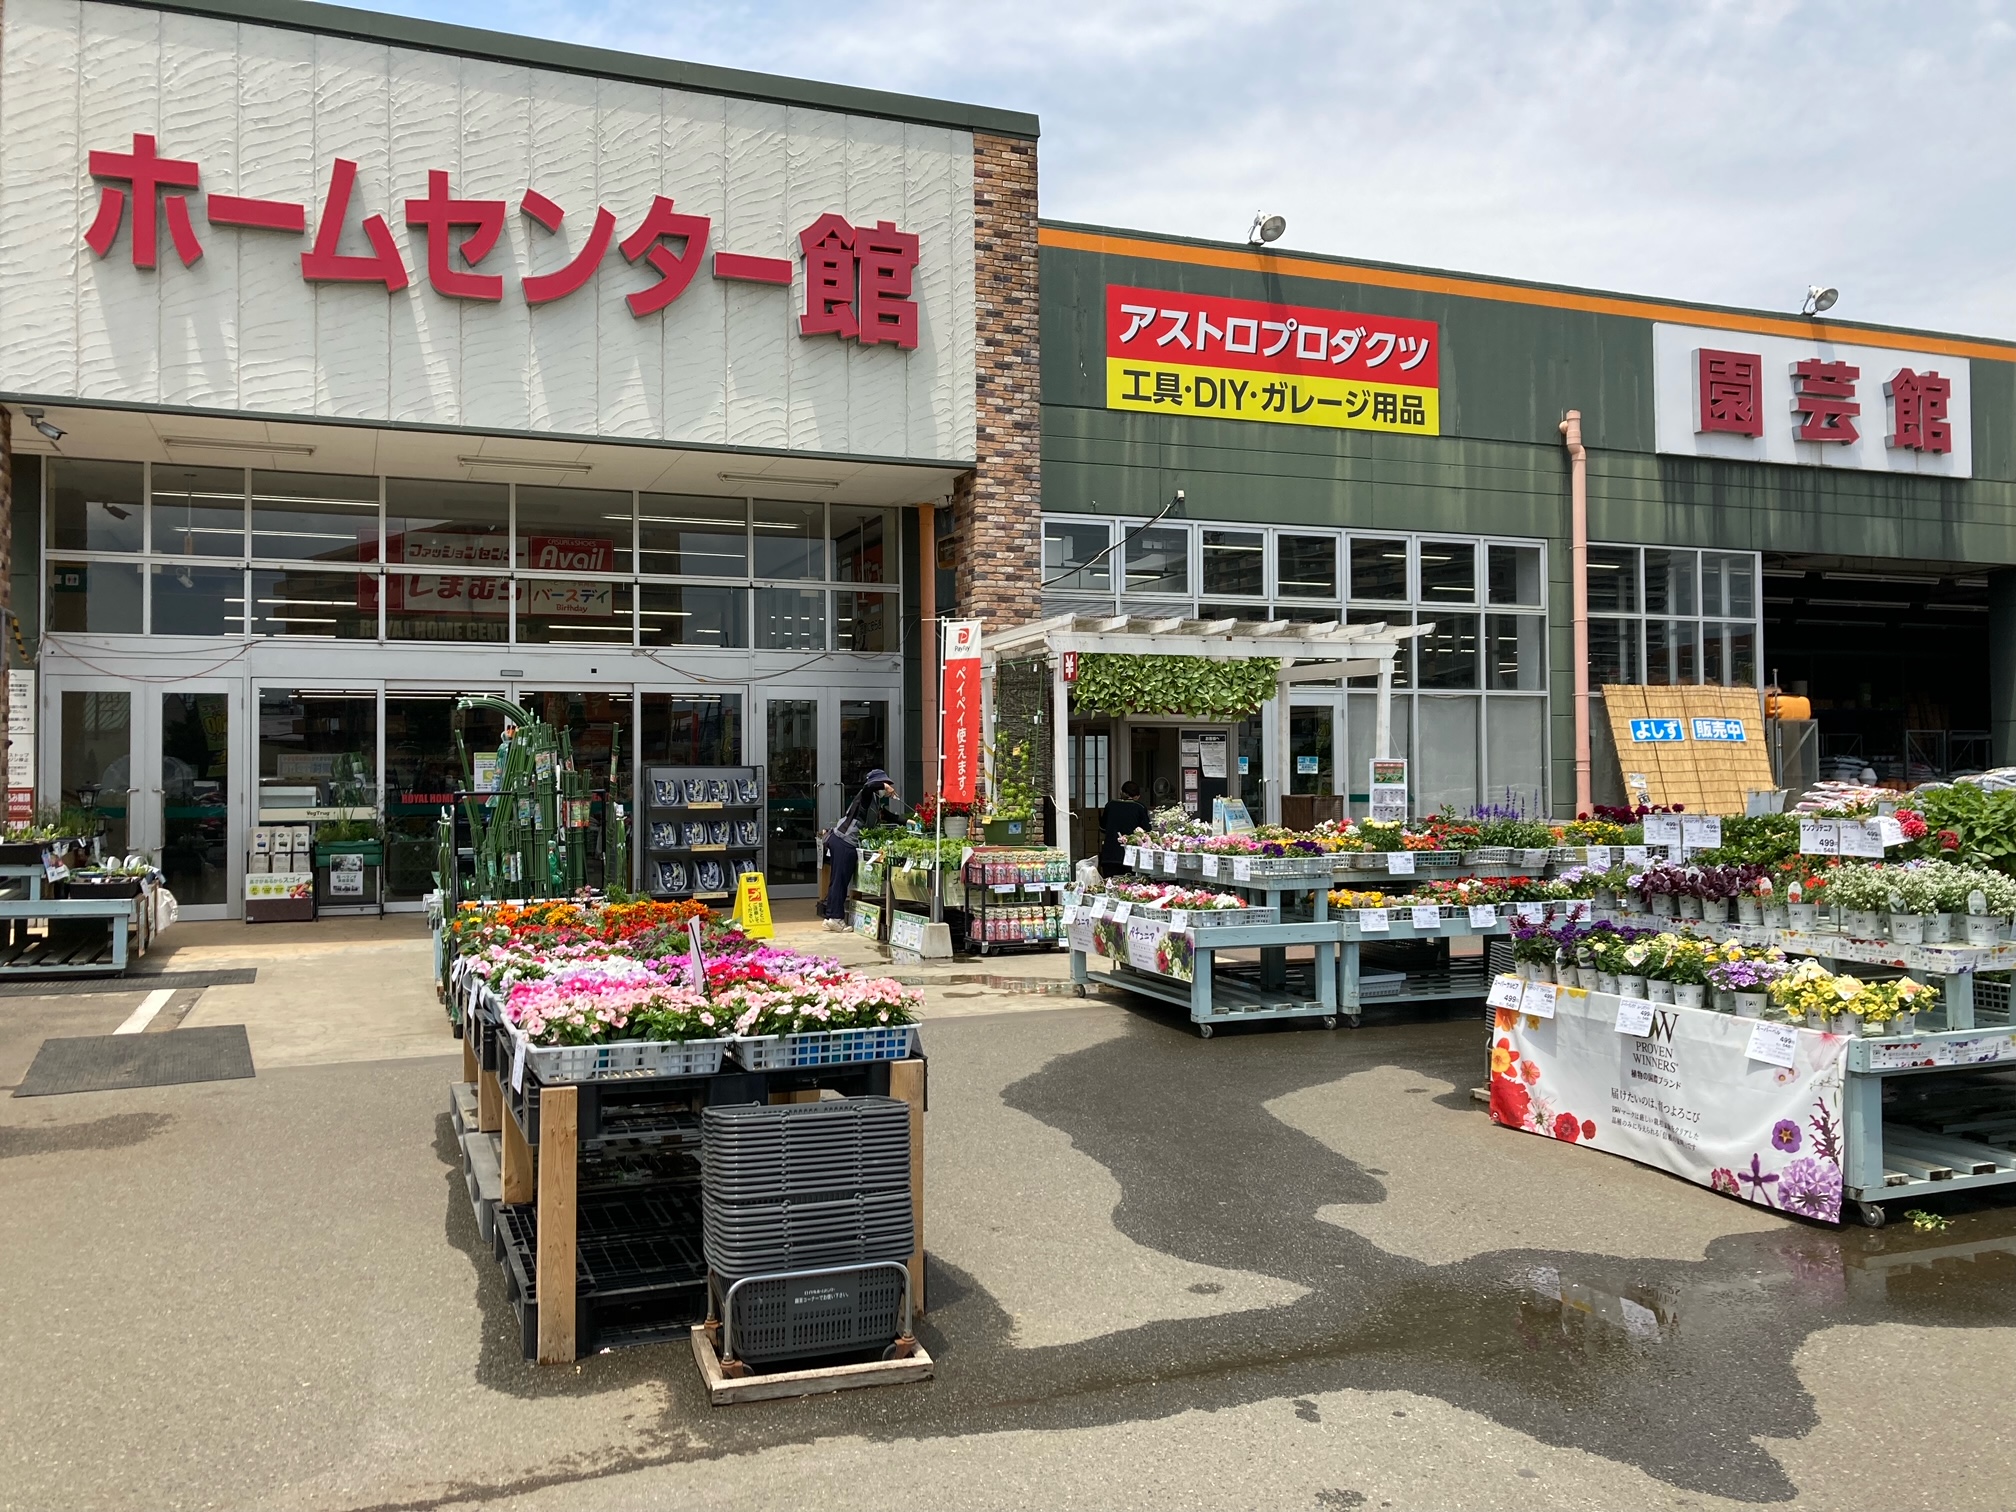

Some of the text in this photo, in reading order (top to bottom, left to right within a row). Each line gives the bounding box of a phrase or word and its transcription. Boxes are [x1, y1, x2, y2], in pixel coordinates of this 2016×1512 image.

[84, 132, 919, 351] ホームセンター館
[1118, 303, 1429, 371] アストロプロダクツ
[1121, 368, 1426, 426] 工具・DIY・ガレージ用品
[1691, 347, 1952, 454] 園芸館
[538, 545, 605, 570] Avail
[556, 603, 588, 613] Birthday
[470, 621, 529, 642] CENTR
[955, 665, 967, 798] ペイペイ使えます。
[1635, 720, 1680, 740] よしず
[1695, 720, 1742, 739] 販売中
[1635, 1041, 1674, 1059] PROVEN
[1632, 1053, 1678, 1074] WINNERS
